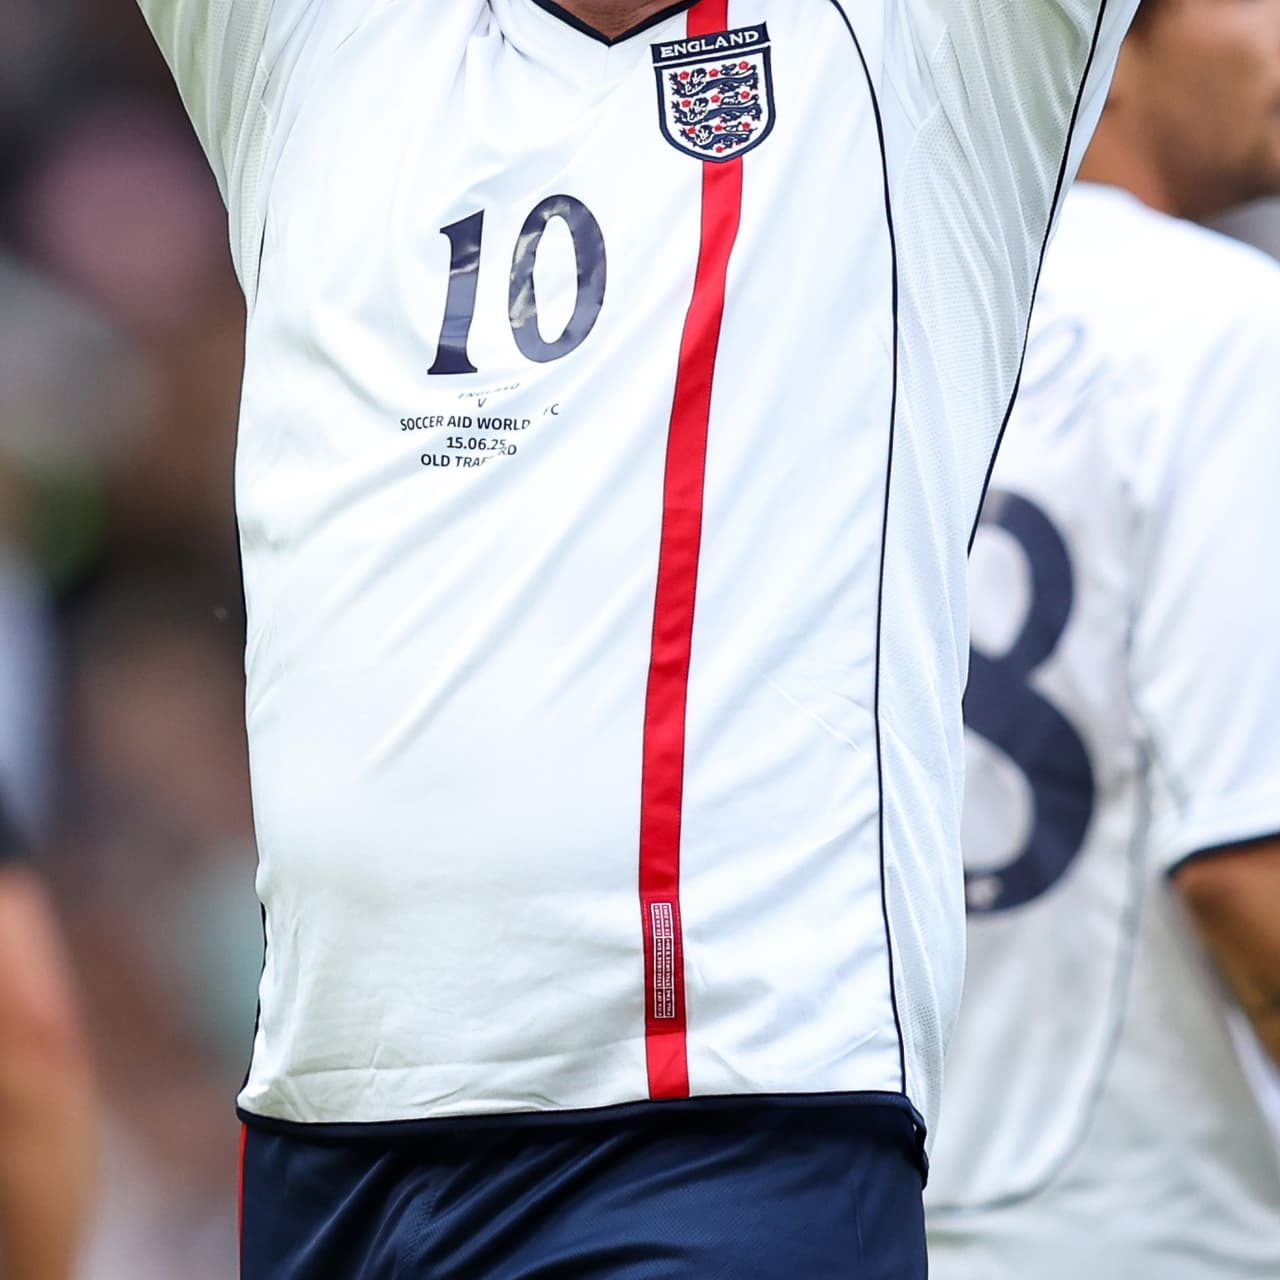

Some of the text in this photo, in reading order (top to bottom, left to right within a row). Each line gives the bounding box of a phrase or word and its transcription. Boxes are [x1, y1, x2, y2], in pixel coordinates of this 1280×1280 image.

[660, 30, 759, 58] ENGLAND
[427, 194, 607, 376] 10
[400, 415, 444, 431] SOCCER
[447, 415, 472, 429] AID
[476, 417, 531, 431] WORLD
[420, 453, 451, 468] OLD
